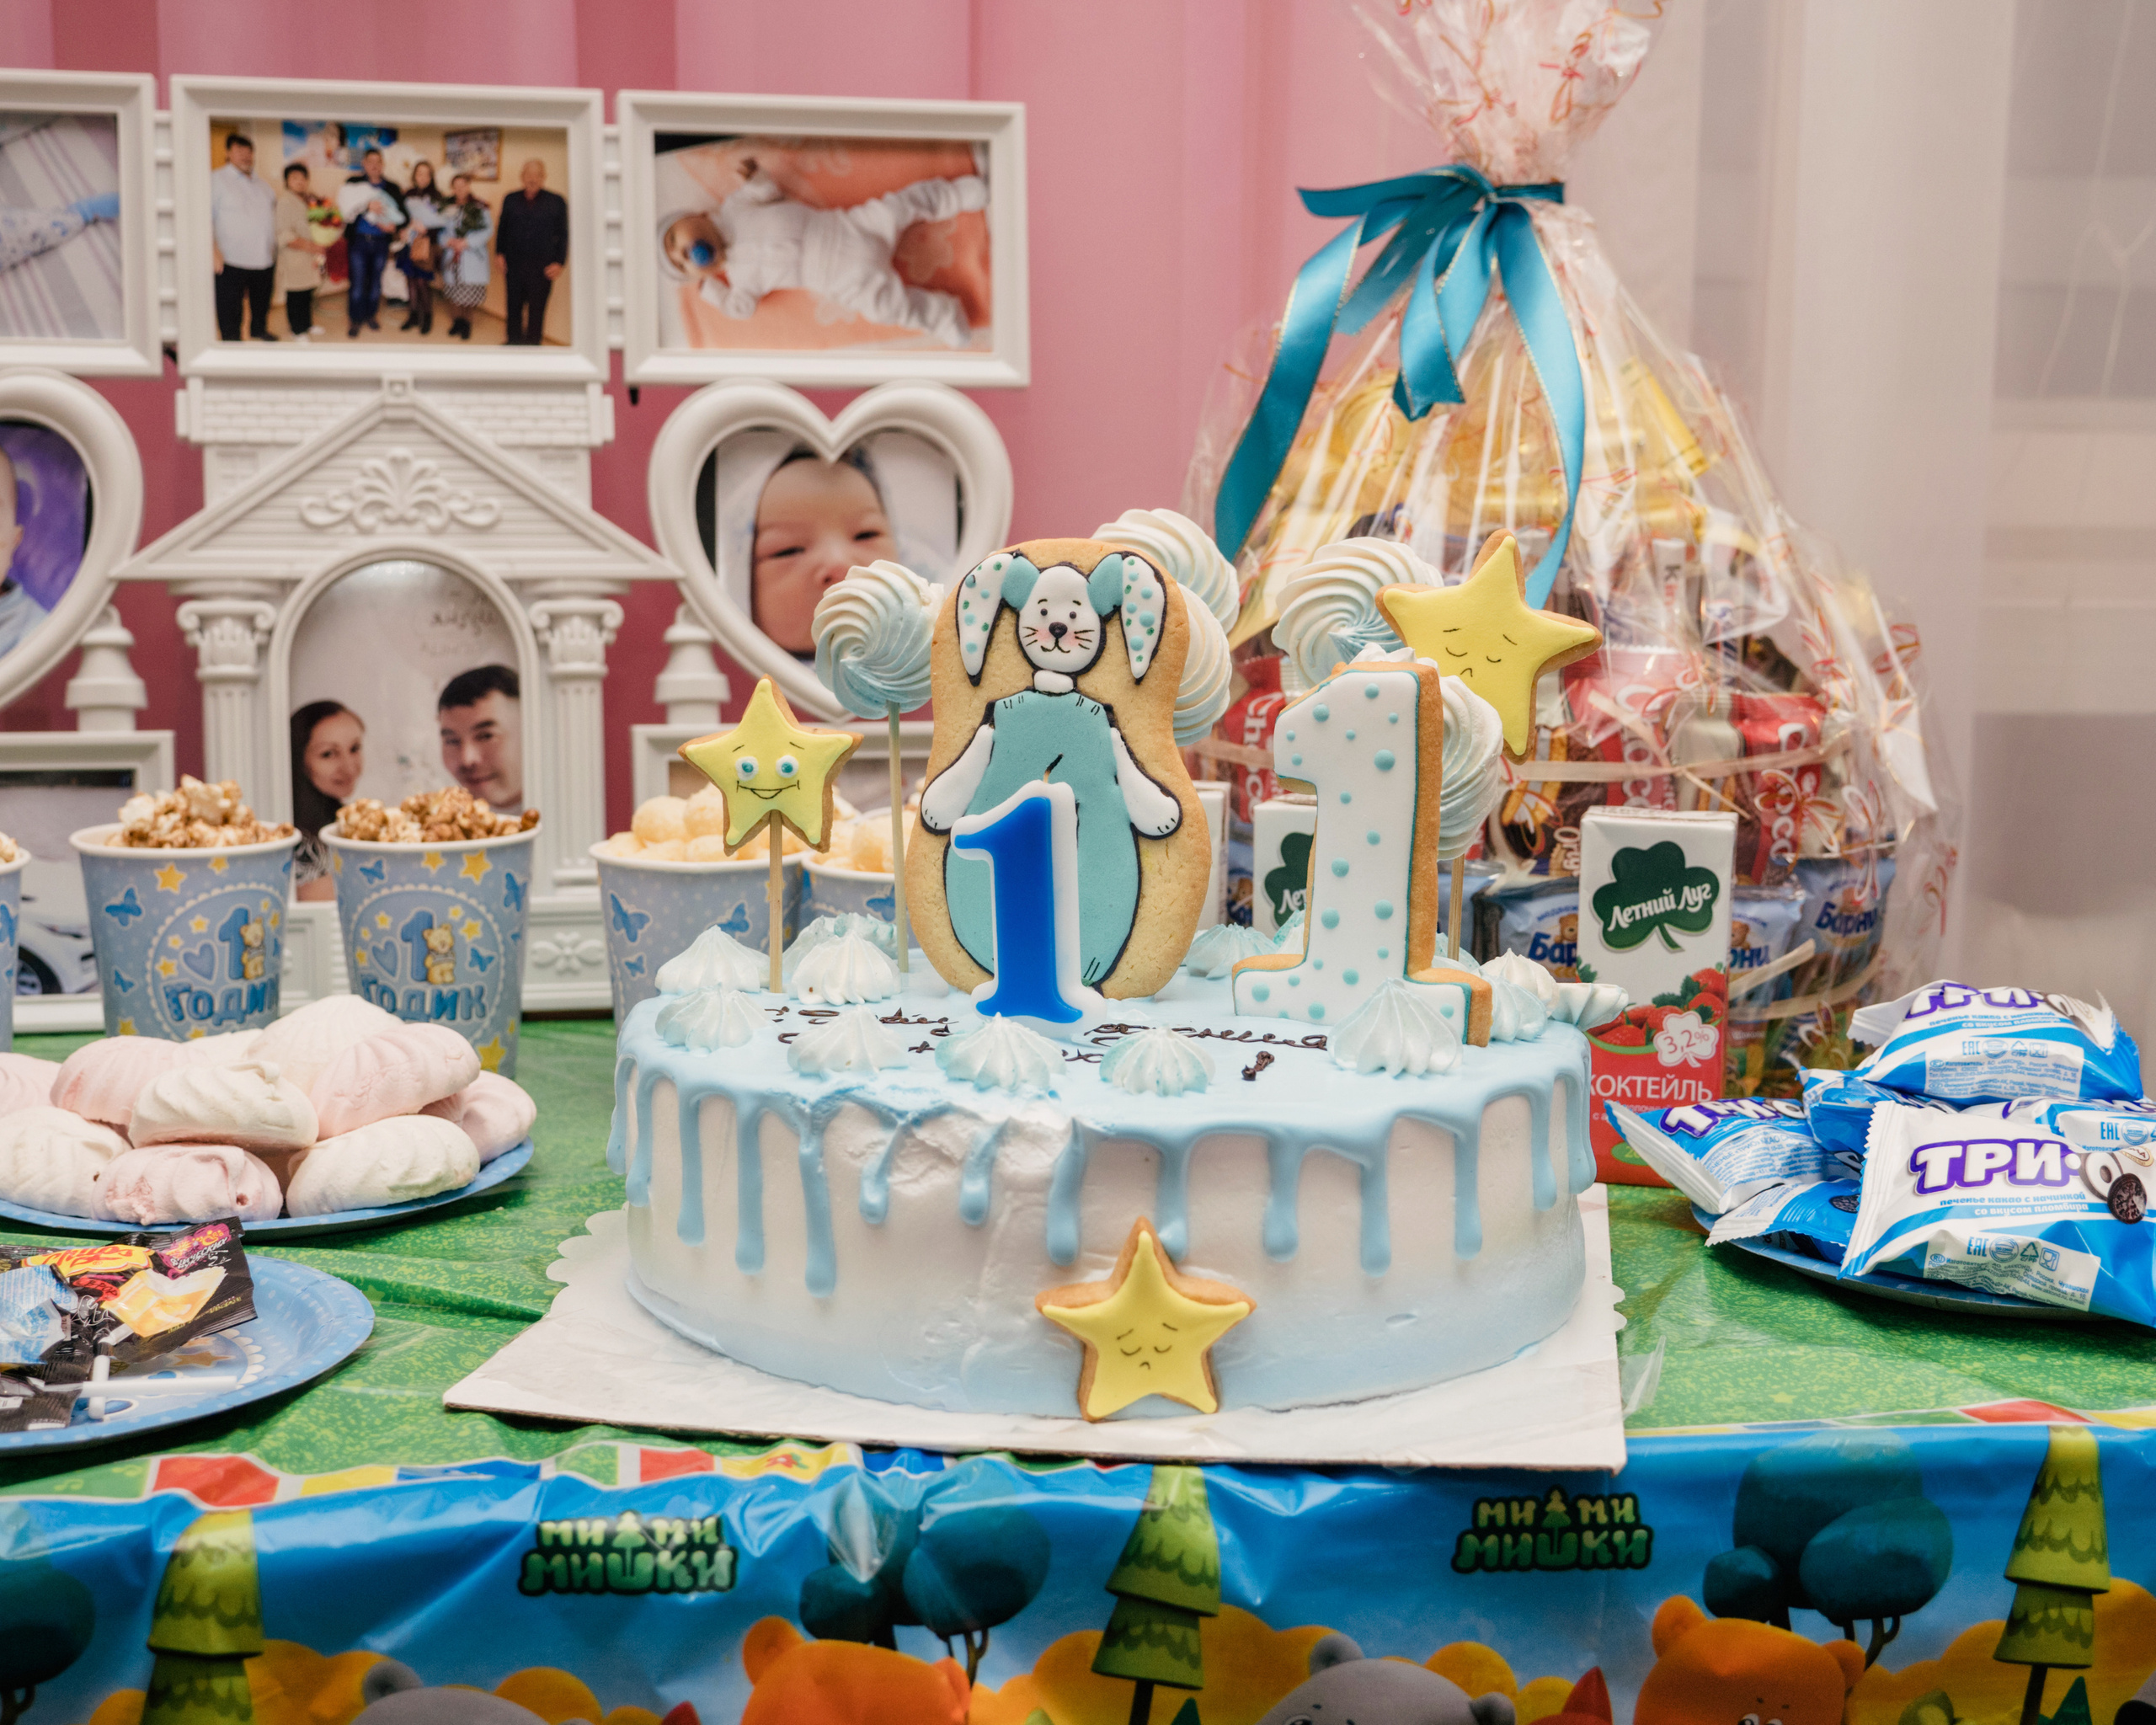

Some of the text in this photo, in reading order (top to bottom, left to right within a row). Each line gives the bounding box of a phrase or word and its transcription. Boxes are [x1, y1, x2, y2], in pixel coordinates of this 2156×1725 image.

[1278, 888, 1306, 914] Лет
[1607, 887, 1677, 932] Летний
[1678, 883, 1713, 913] Луг
[1529, 932, 1577, 967] Бар
[1662, 1029, 1710, 1055] 3,2%
[1710, 1151, 1735, 1174] ЕЧЕНЬЕ
[1940, 1197, 1986, 1206] печенье
[2033, 1191, 2086, 1202] начинкой
[1991, 1206, 2031, 1217] вкусом
[2034, 1203, 2089, 1213] пломбира
[1966, 1236, 1989, 1258] EAC
[1454, 1528, 1650, 1570] МИШКИ
[520, 1548, 736, 1592] МИШКИ
